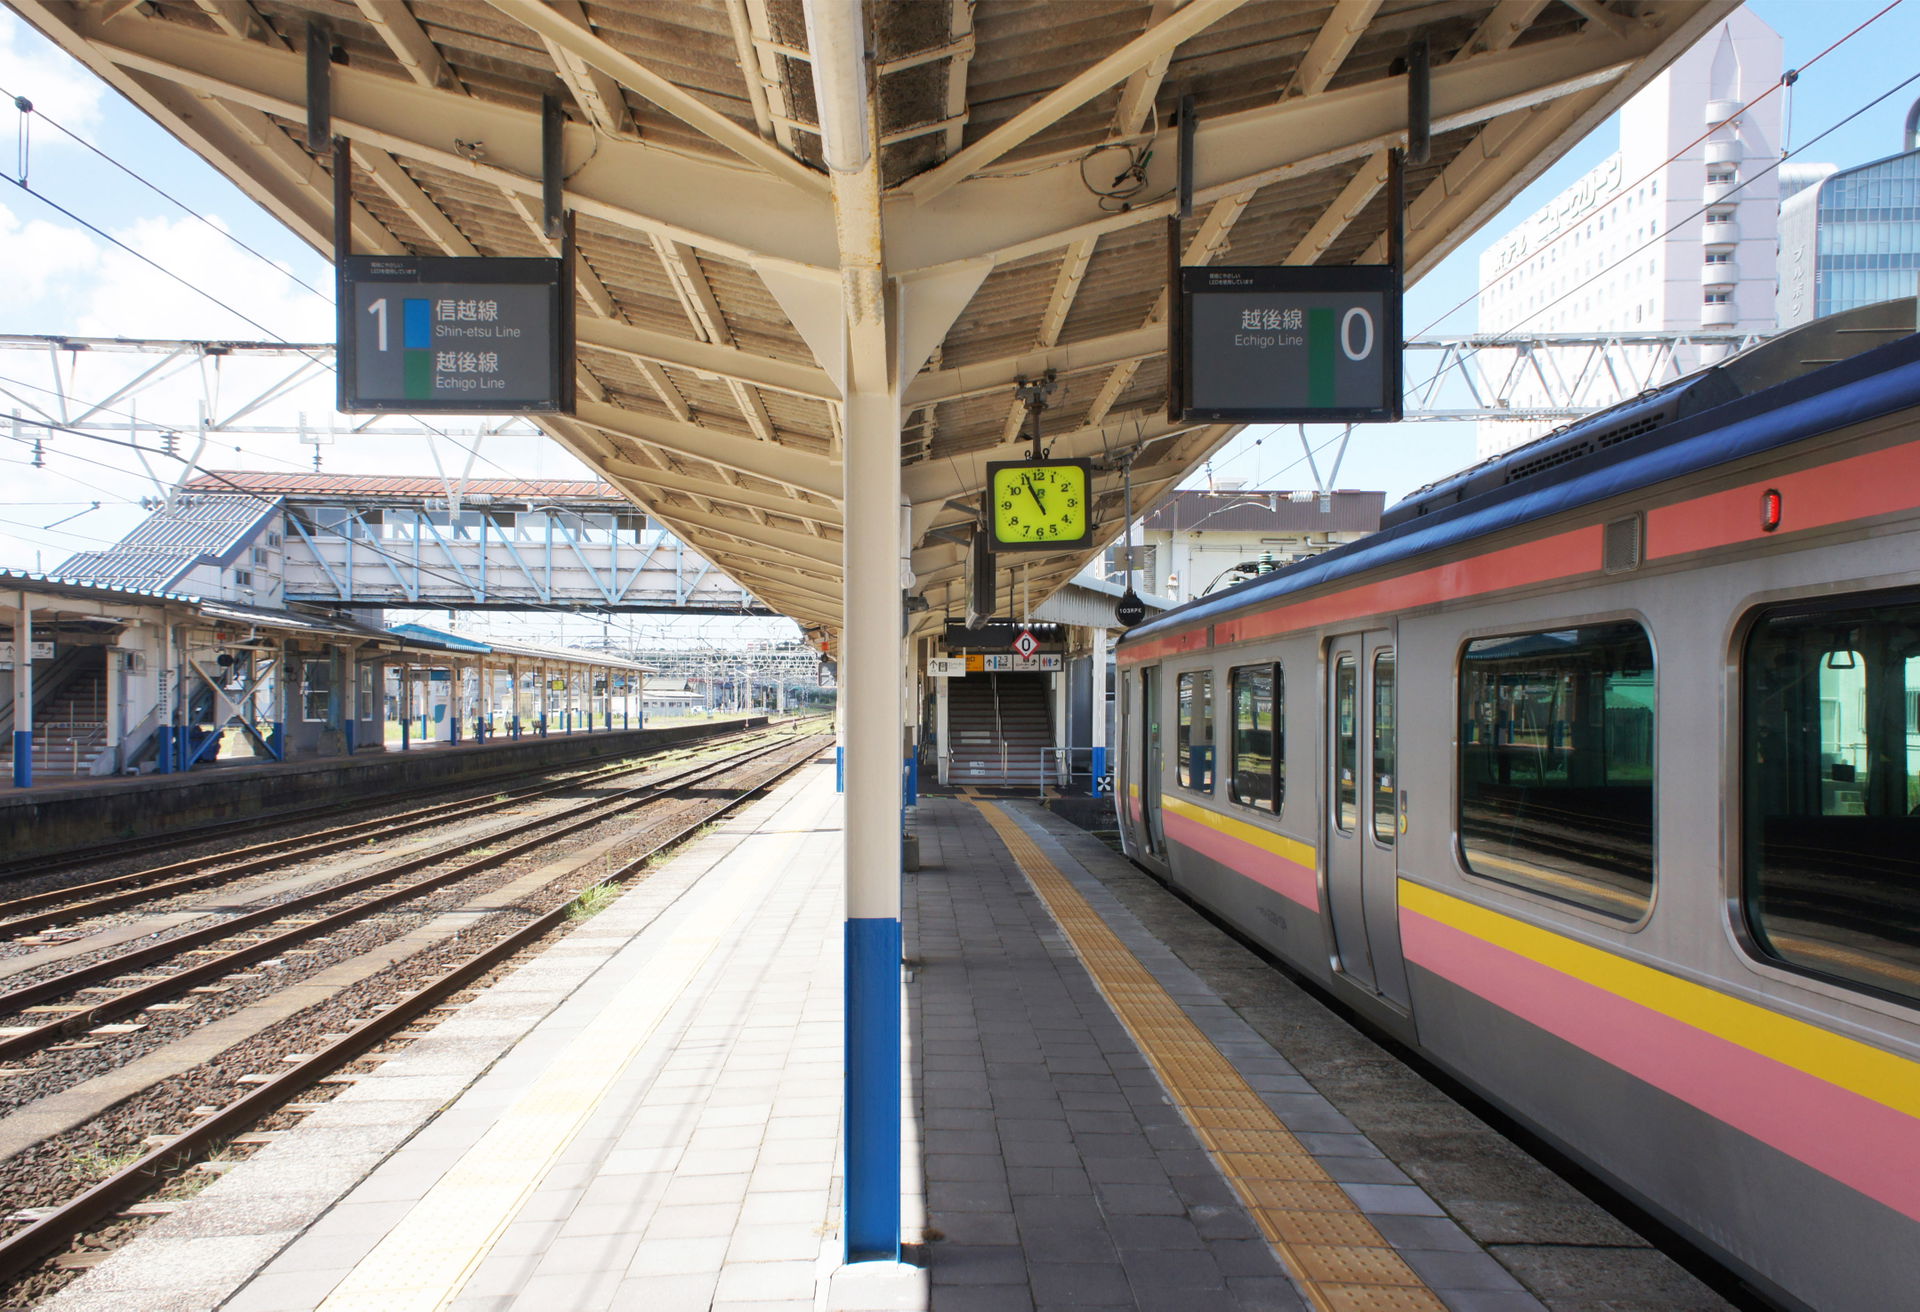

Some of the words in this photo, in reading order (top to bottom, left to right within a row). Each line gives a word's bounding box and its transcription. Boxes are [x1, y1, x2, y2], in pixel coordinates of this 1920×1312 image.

[435, 300, 498, 322] 信越線
[367, 298, 388, 351] 1
[1241, 308, 1303, 331] 越後線
[435, 325, 492, 338] Shin-etsu
[495, 325, 521, 338] Line
[1341, 306, 1374, 361] 0
[1234, 334, 1275, 349] Echigo
[1278, 334, 1303, 346] Line
[435, 352, 499, 373] 越後線
[435, 376, 476, 391] Echigo
[480, 377, 505, 389] Line
[1033, 472, 1045, 481] 12
[1010, 486, 1022, 496] 10
[1060, 483, 1069, 493] 2
[1004, 501, 1012, 511] 9
[1067, 498, 1075, 508] 3
[1010, 516, 1019, 526] 8
[1061, 514, 1069, 524] 4
[1023, 525, 1031, 535] 7
[1036, 527, 1044, 537] 6
[1049, 524, 1057, 534] 5
[1021, 637, 1031, 652] 0
